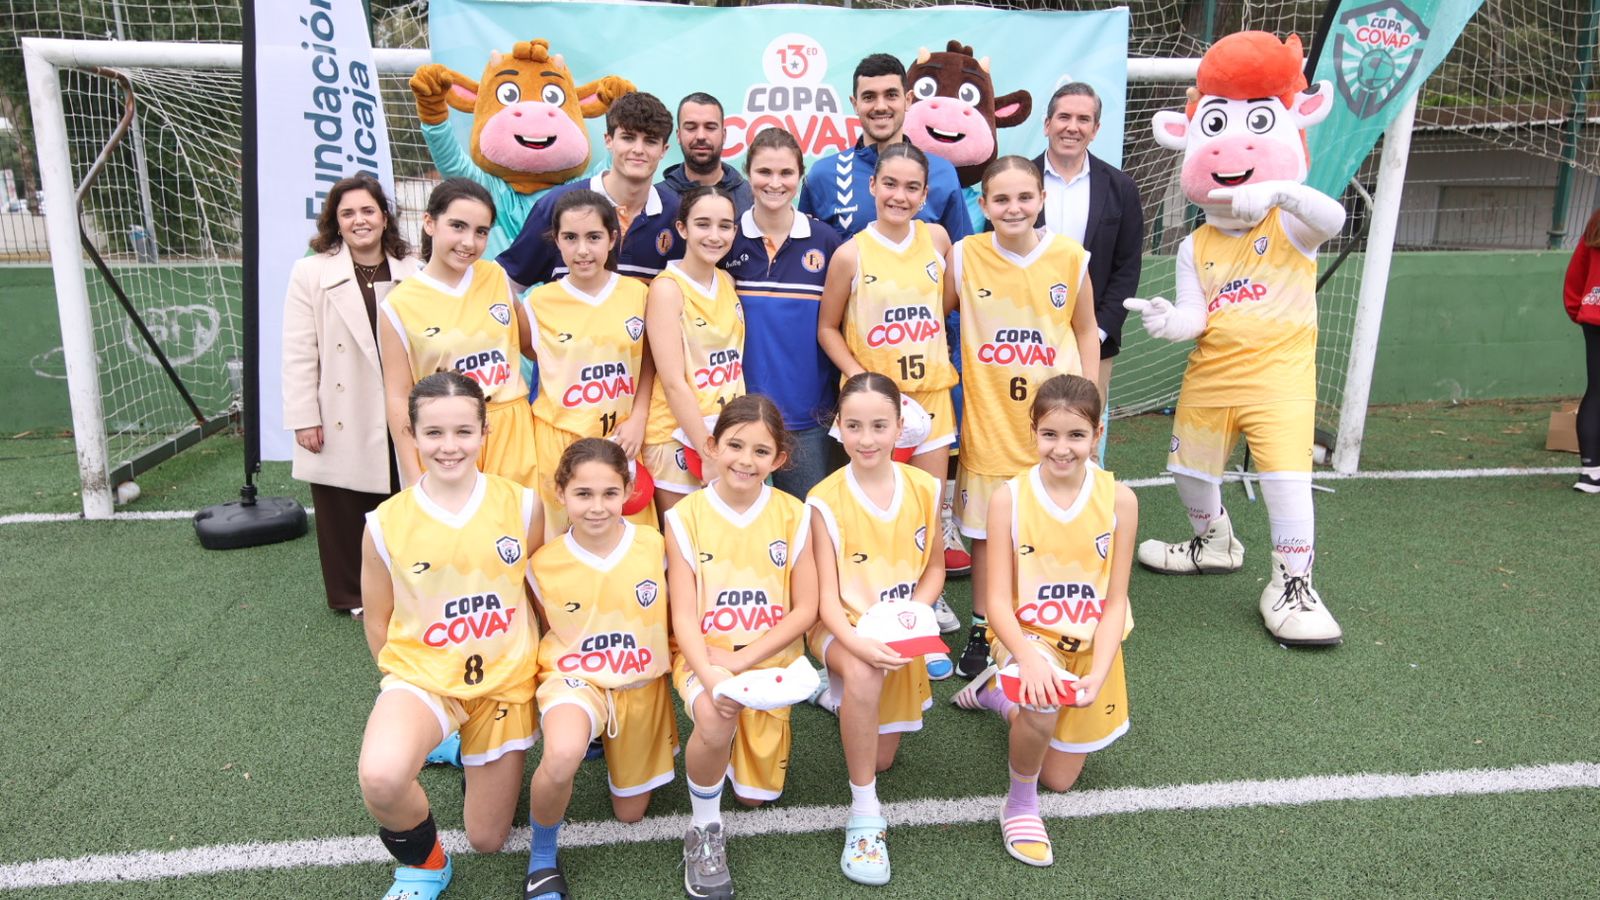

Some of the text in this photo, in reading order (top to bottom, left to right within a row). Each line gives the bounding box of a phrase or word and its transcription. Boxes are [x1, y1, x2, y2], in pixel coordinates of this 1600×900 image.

[1371, 17, 1402, 31] COPA
[1356, 27, 1411, 48] COVAP
[776, 44, 809, 79] 13
[747, 86, 838, 114] COPA
[884, 306, 931, 323] COPA
[995, 329, 1043, 345] COPA
[455, 350, 505, 373] COPA
[977, 343, 1056, 367] COVAP
[581, 362, 625, 381] COPA
[897, 355, 925, 380] 15
[1010, 377, 1027, 401] 6
[600, 411, 617, 437] 11
[1276, 545, 1310, 553] COVAP
[716, 590, 768, 606] COPA
[1038, 584, 1095, 600] COPA
[445, 594, 500, 619] COPA
[582, 633, 636, 652] COPA
[1057, 634, 1081, 653] 9
[464, 655, 484, 685] 8
[557, 648, 652, 675] COVAP
